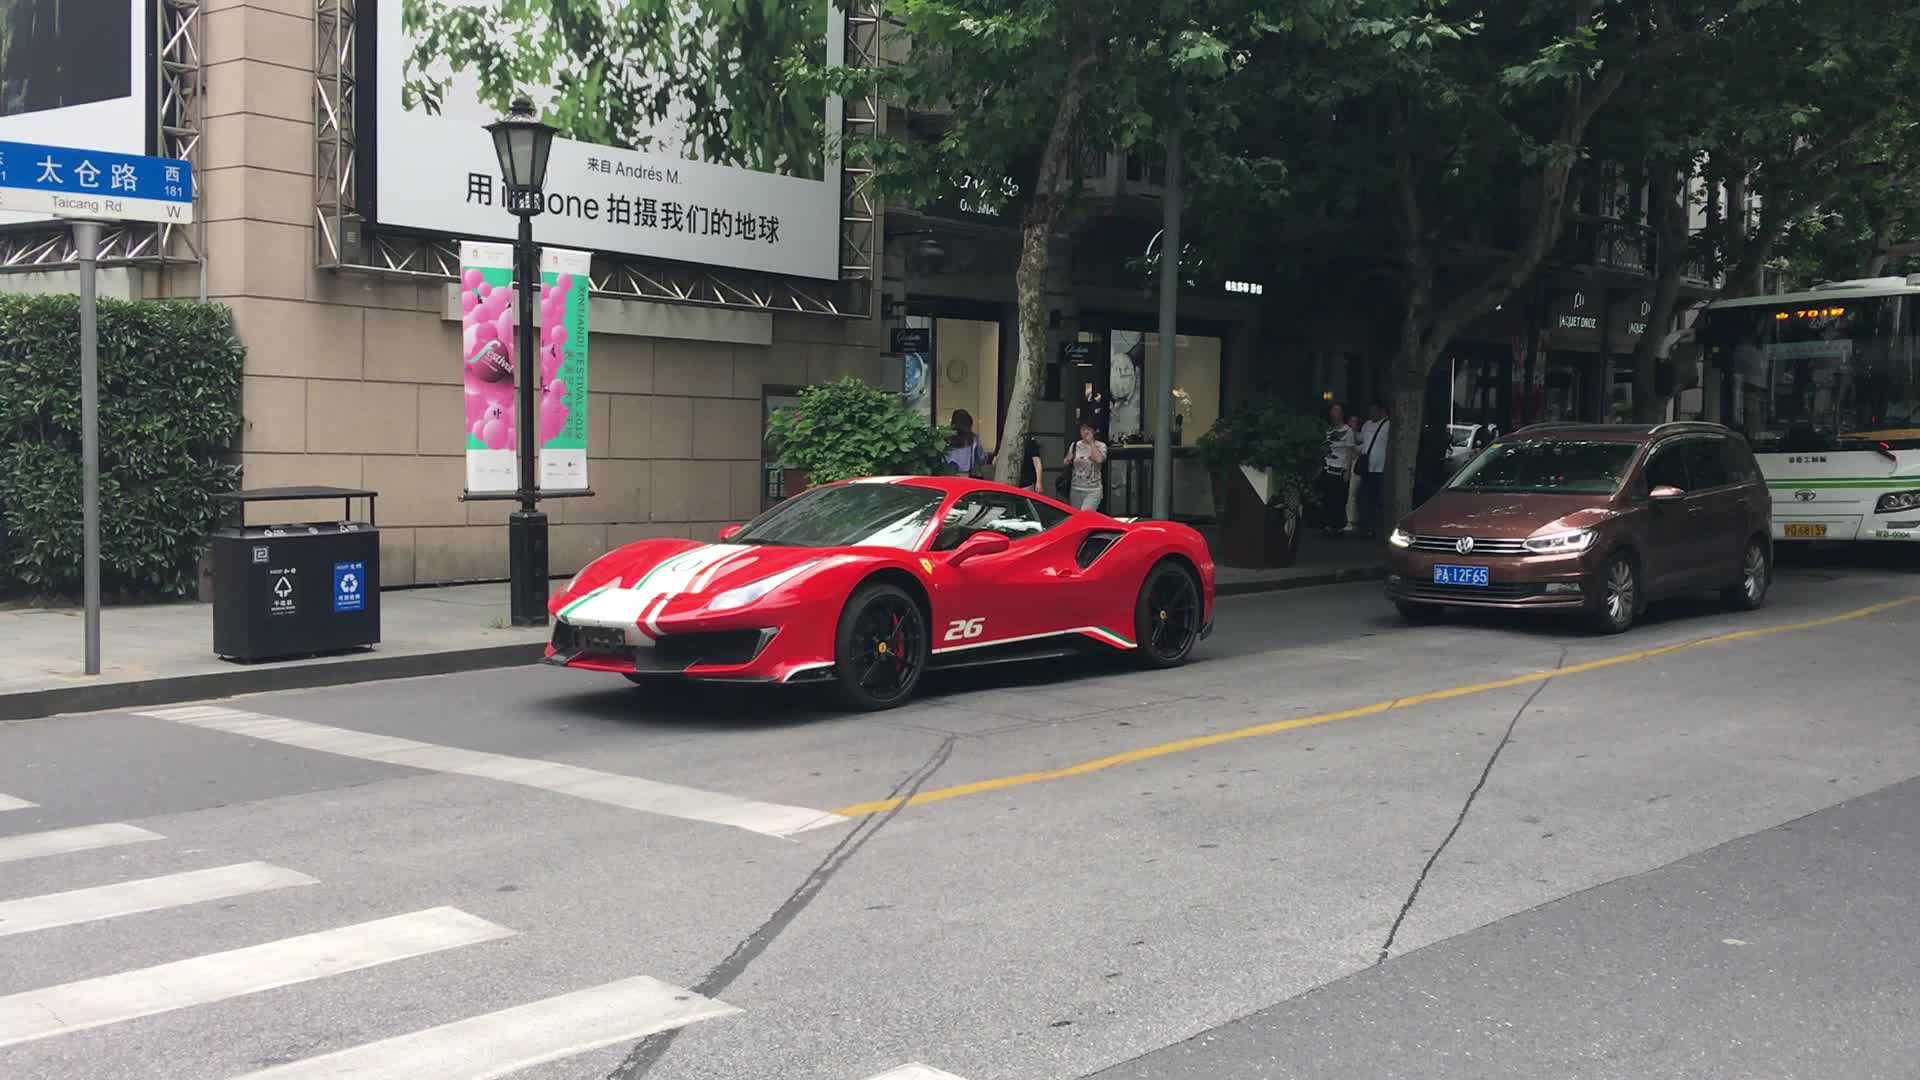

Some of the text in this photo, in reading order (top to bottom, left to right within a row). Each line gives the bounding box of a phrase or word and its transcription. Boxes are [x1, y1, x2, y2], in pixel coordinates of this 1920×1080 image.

[36, 155, 138, 191] 太仓路
[165, 165, 181, 183] 西
[587, 157, 683, 184] 来自 Andrés M.
[164, 185, 182, 197] 181
[52, 196, 122, 213] Taicang Rd
[167, 206, 181, 218] W
[466, 172, 779, 244] 用 ione 拍摄我们的地球
[576, 352, 586, 406] FESTIVAL
[576, 411, 585, 440] 2019
[944, 617, 986, 641] 26
